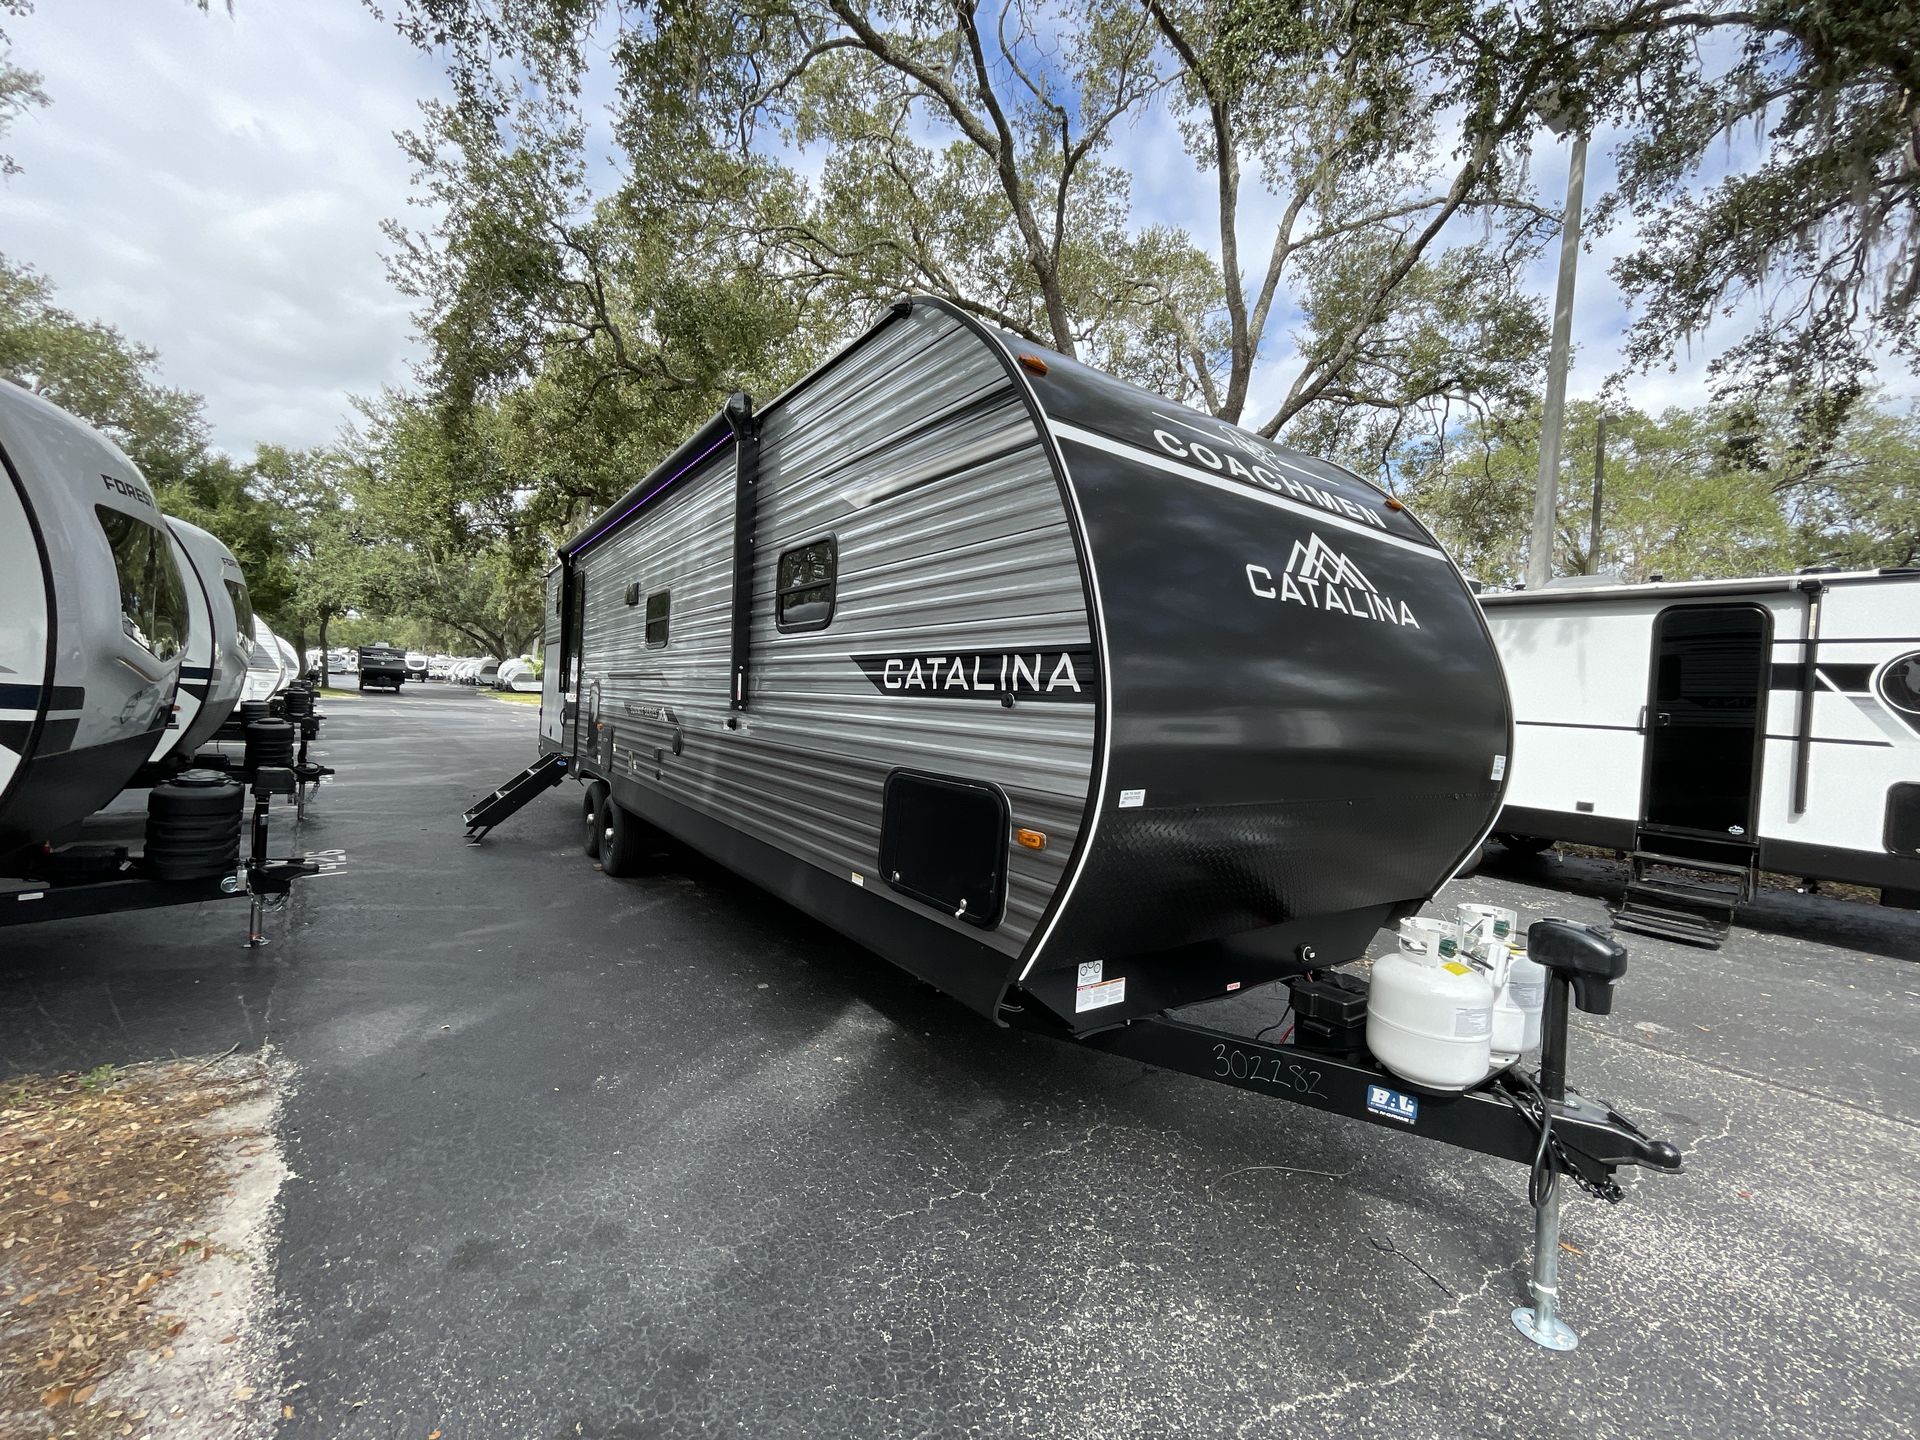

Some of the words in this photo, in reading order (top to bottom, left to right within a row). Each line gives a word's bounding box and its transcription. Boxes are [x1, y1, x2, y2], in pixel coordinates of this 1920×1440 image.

[1153, 429, 1387, 529] COACHMEN
[1245, 563, 1421, 630] CATALINA
[883, 652, 1082, 694] CATALINA
[1212, 1043, 1329, 1100] 302282
